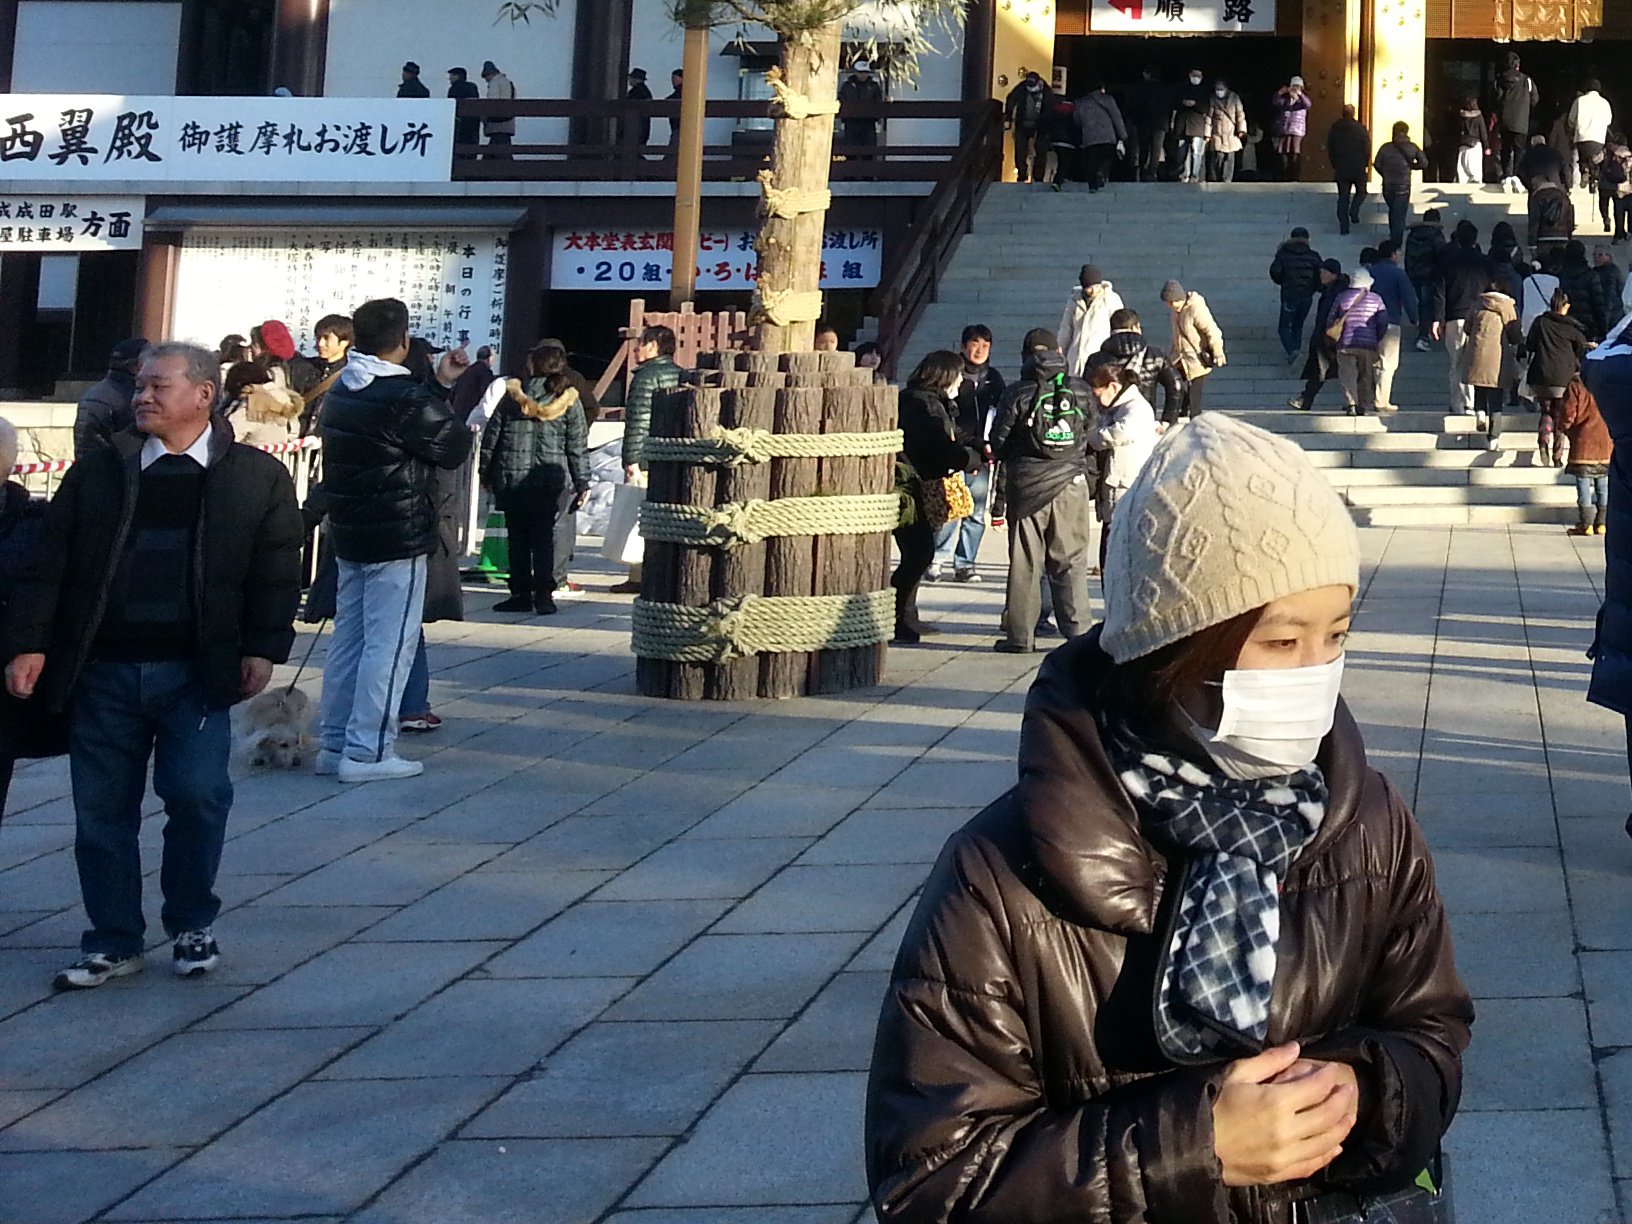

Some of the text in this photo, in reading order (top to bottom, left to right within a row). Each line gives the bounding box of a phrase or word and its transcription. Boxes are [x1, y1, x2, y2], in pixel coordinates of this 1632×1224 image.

[0, 108, 434, 166] 西翼殿 御護摩札お渡し所
[80, 210, 132, 239] 方面
[457, 244, 476, 343] 本日の行事
